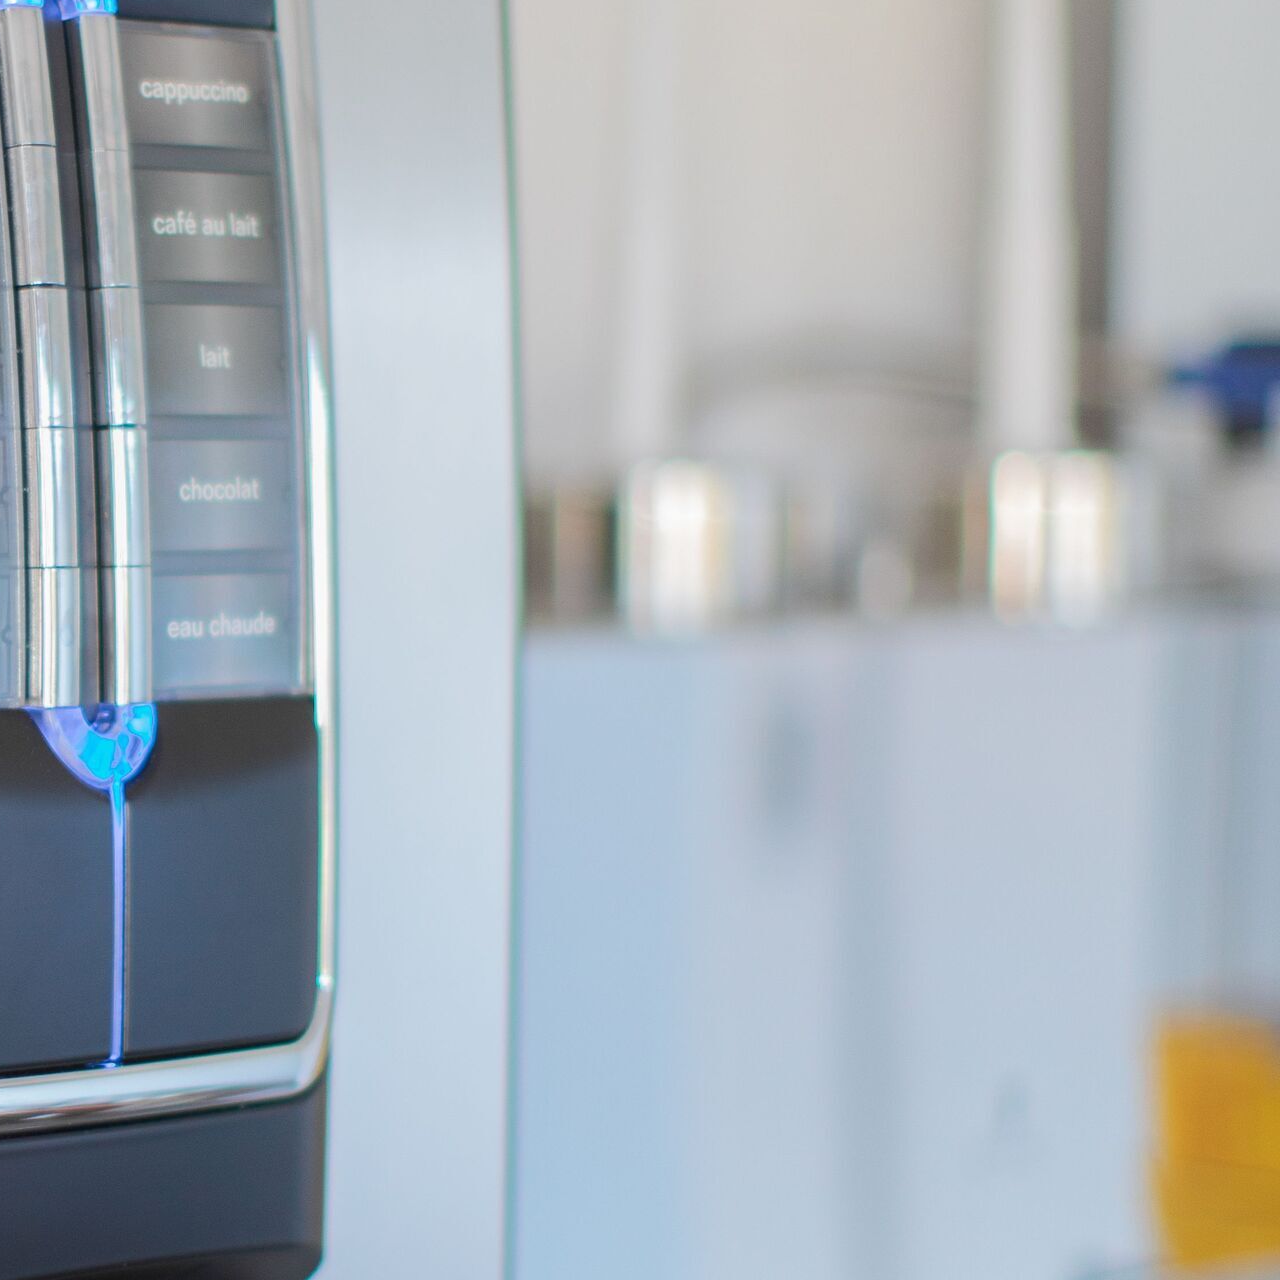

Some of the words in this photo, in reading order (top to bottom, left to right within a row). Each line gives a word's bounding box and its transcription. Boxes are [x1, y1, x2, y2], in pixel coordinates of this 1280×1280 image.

[140, 80, 251, 105] cappuccino
[153, 210, 197, 235] café
[202, 218, 225, 237] au
[230, 213, 260, 238] lait
[200, 345, 231, 369] lait
[179, 477, 260, 502] chocolat
[167, 618, 204, 638] eau
[209, 612, 275, 637] chaude
